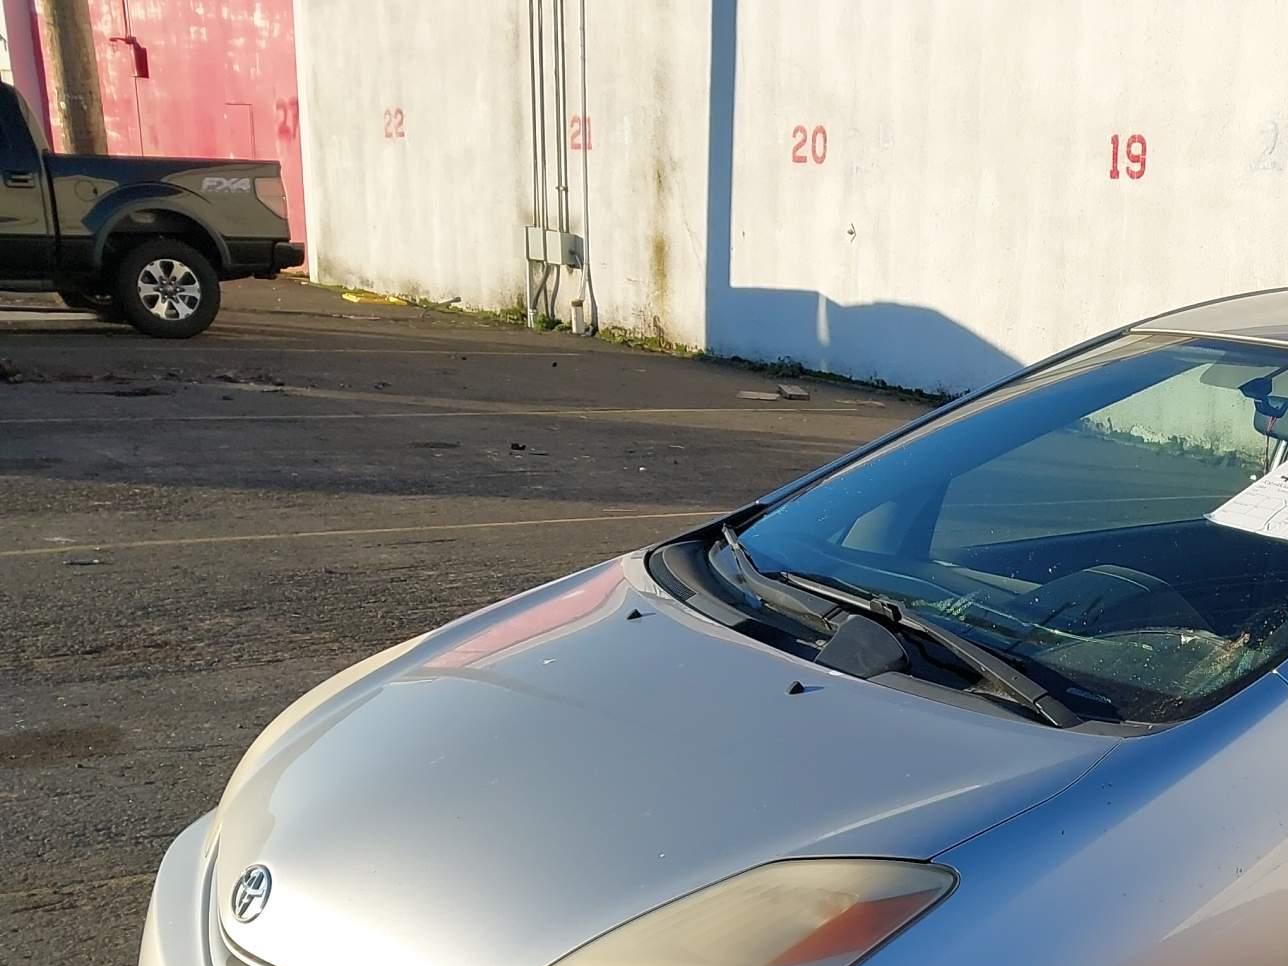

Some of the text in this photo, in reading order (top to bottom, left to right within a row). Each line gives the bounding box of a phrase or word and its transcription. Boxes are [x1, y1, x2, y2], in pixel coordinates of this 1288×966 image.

[384, 108, 405, 138] 22
[570, 115, 592, 151] 21
[792, 126, 827, 165] 20
[1110, 134, 1147, 180] 19
[201, 177, 250, 192] FX4
